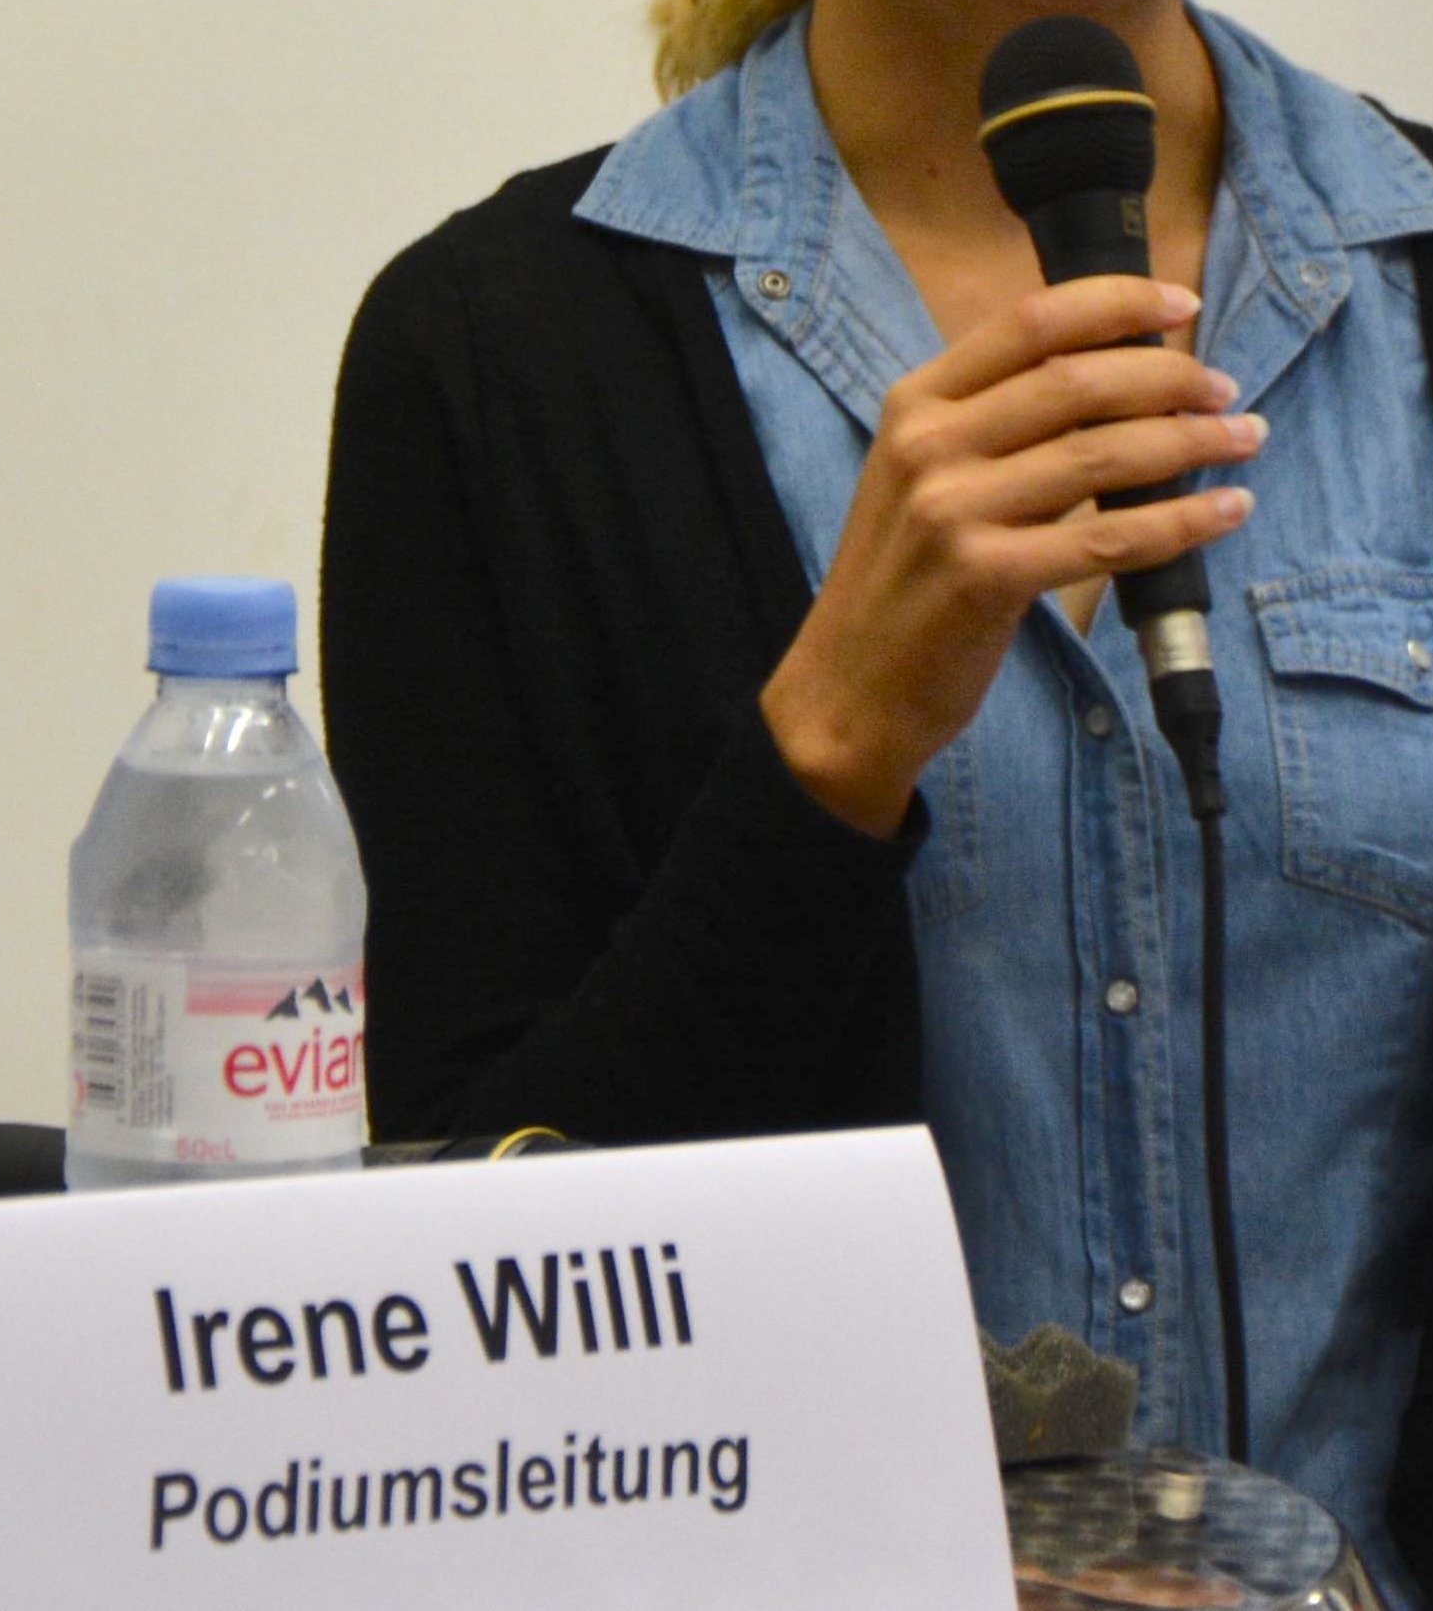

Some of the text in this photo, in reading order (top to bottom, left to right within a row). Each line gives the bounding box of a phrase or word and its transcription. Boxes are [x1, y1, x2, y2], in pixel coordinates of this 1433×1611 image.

[153, 1242, 694, 1393] Irene Willi
[149, 1433, 750, 1551] Podiumsleitung
